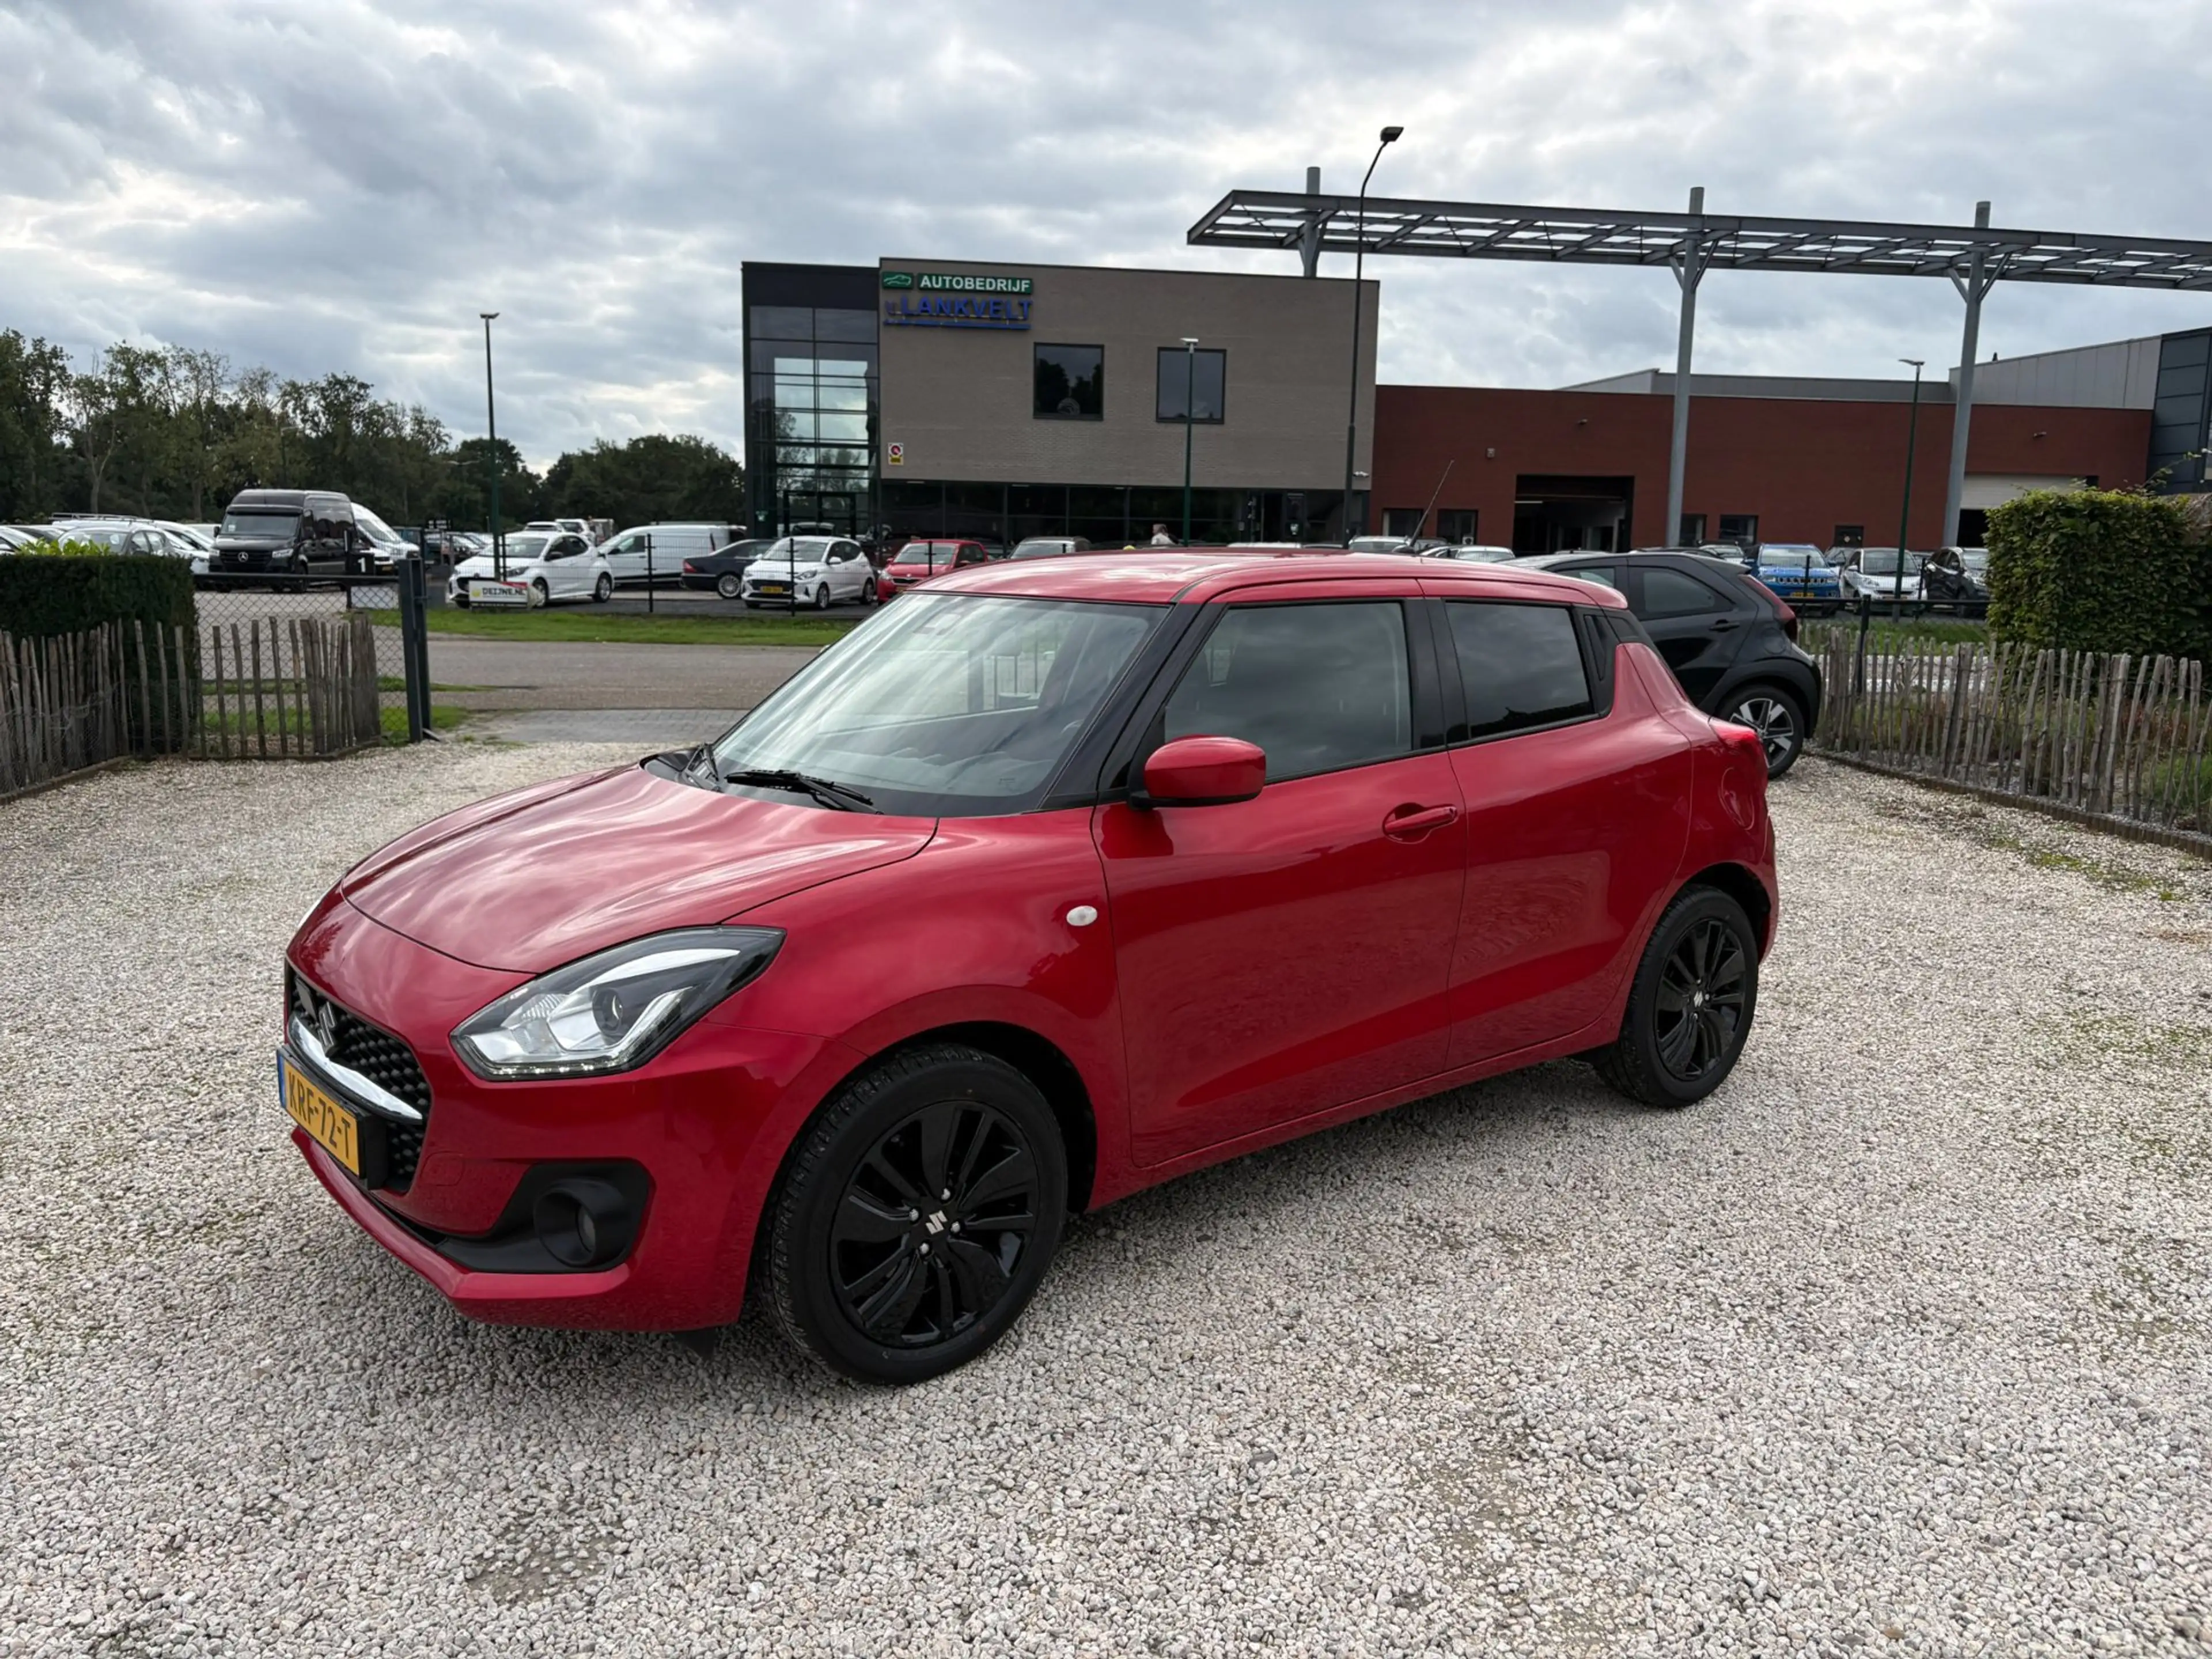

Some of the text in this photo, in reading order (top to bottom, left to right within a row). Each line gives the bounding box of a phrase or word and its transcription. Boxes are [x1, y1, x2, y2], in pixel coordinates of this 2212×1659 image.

[921, 275, 1030, 291] AUTOBEDRIJF
[902, 296, 1032, 320] LANKVELT
[357, 557, 366, 573] 1
[289, 1072, 350, 1160] KRF-72-T
